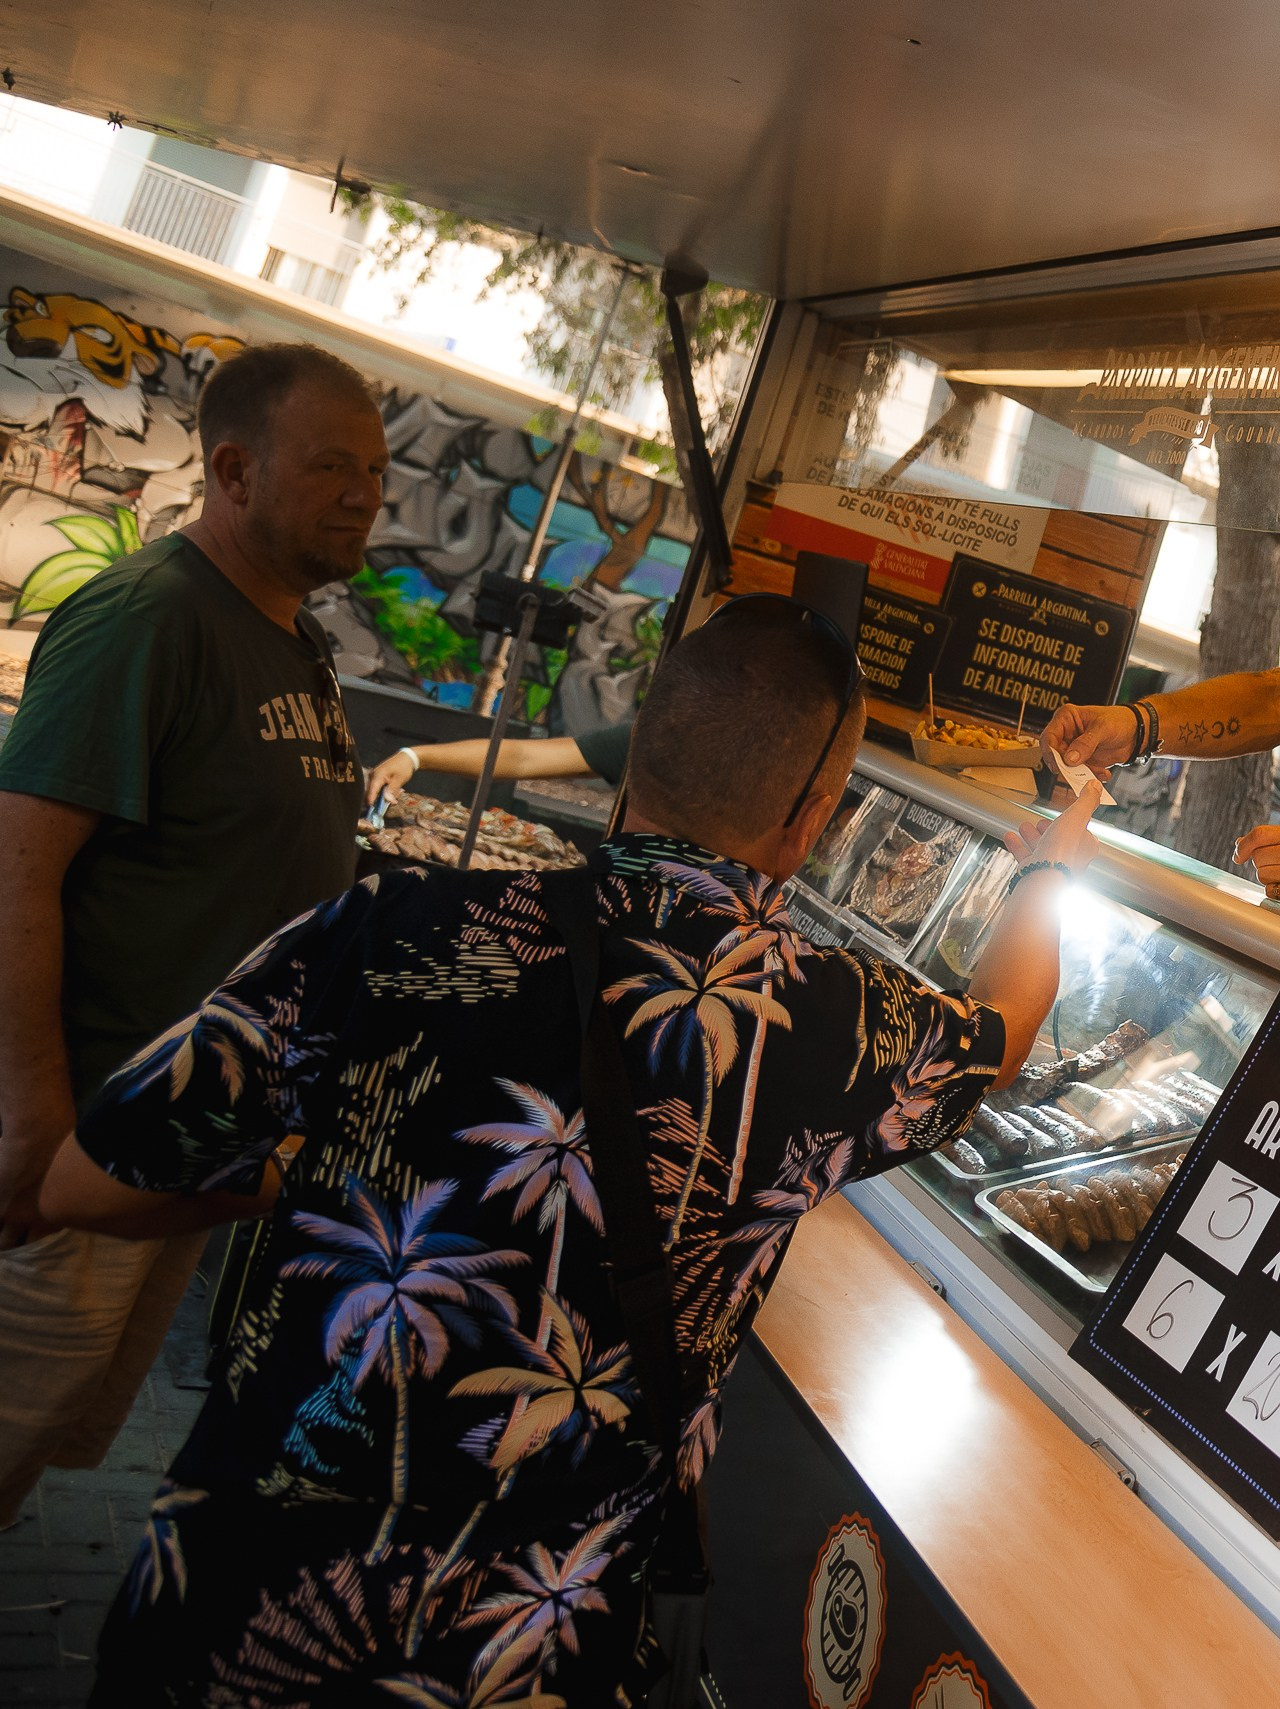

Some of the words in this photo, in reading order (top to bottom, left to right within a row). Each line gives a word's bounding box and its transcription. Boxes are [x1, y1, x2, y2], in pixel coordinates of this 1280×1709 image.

[838, 495, 859, 511] DE
[860, 502, 884, 521] QUI
[884, 510, 911, 529] ELS
[934, 511, 944, 523] A
[946, 513, 1019, 547] DISPOSICIÓ
[964, 502, 980, 518] TÉ
[980, 508, 1020, 532] FULLS
[998, 583, 1037, 608] PARRILLA
[1040, 597, 1088, 623] ARGENTINA
[860, 624, 899, 649] ISPONE
[898, 638, 915, 655] DE
[978, 618, 1000, 640] SE
[1000, 624, 1064, 660] DISPONE
[1064, 643, 1084, 665] DE
[962, 667, 985, 689] DE
[972, 643, 1075, 689] INFORMACIÓN
[259, 693, 322, 741] JEAN
[300, 756, 356, 783] FRACE
[906, 804, 943, 833] BURGER
[1206, 1177, 1259, 1241] 3
[1145, 1280, 1194, 1339] 6
